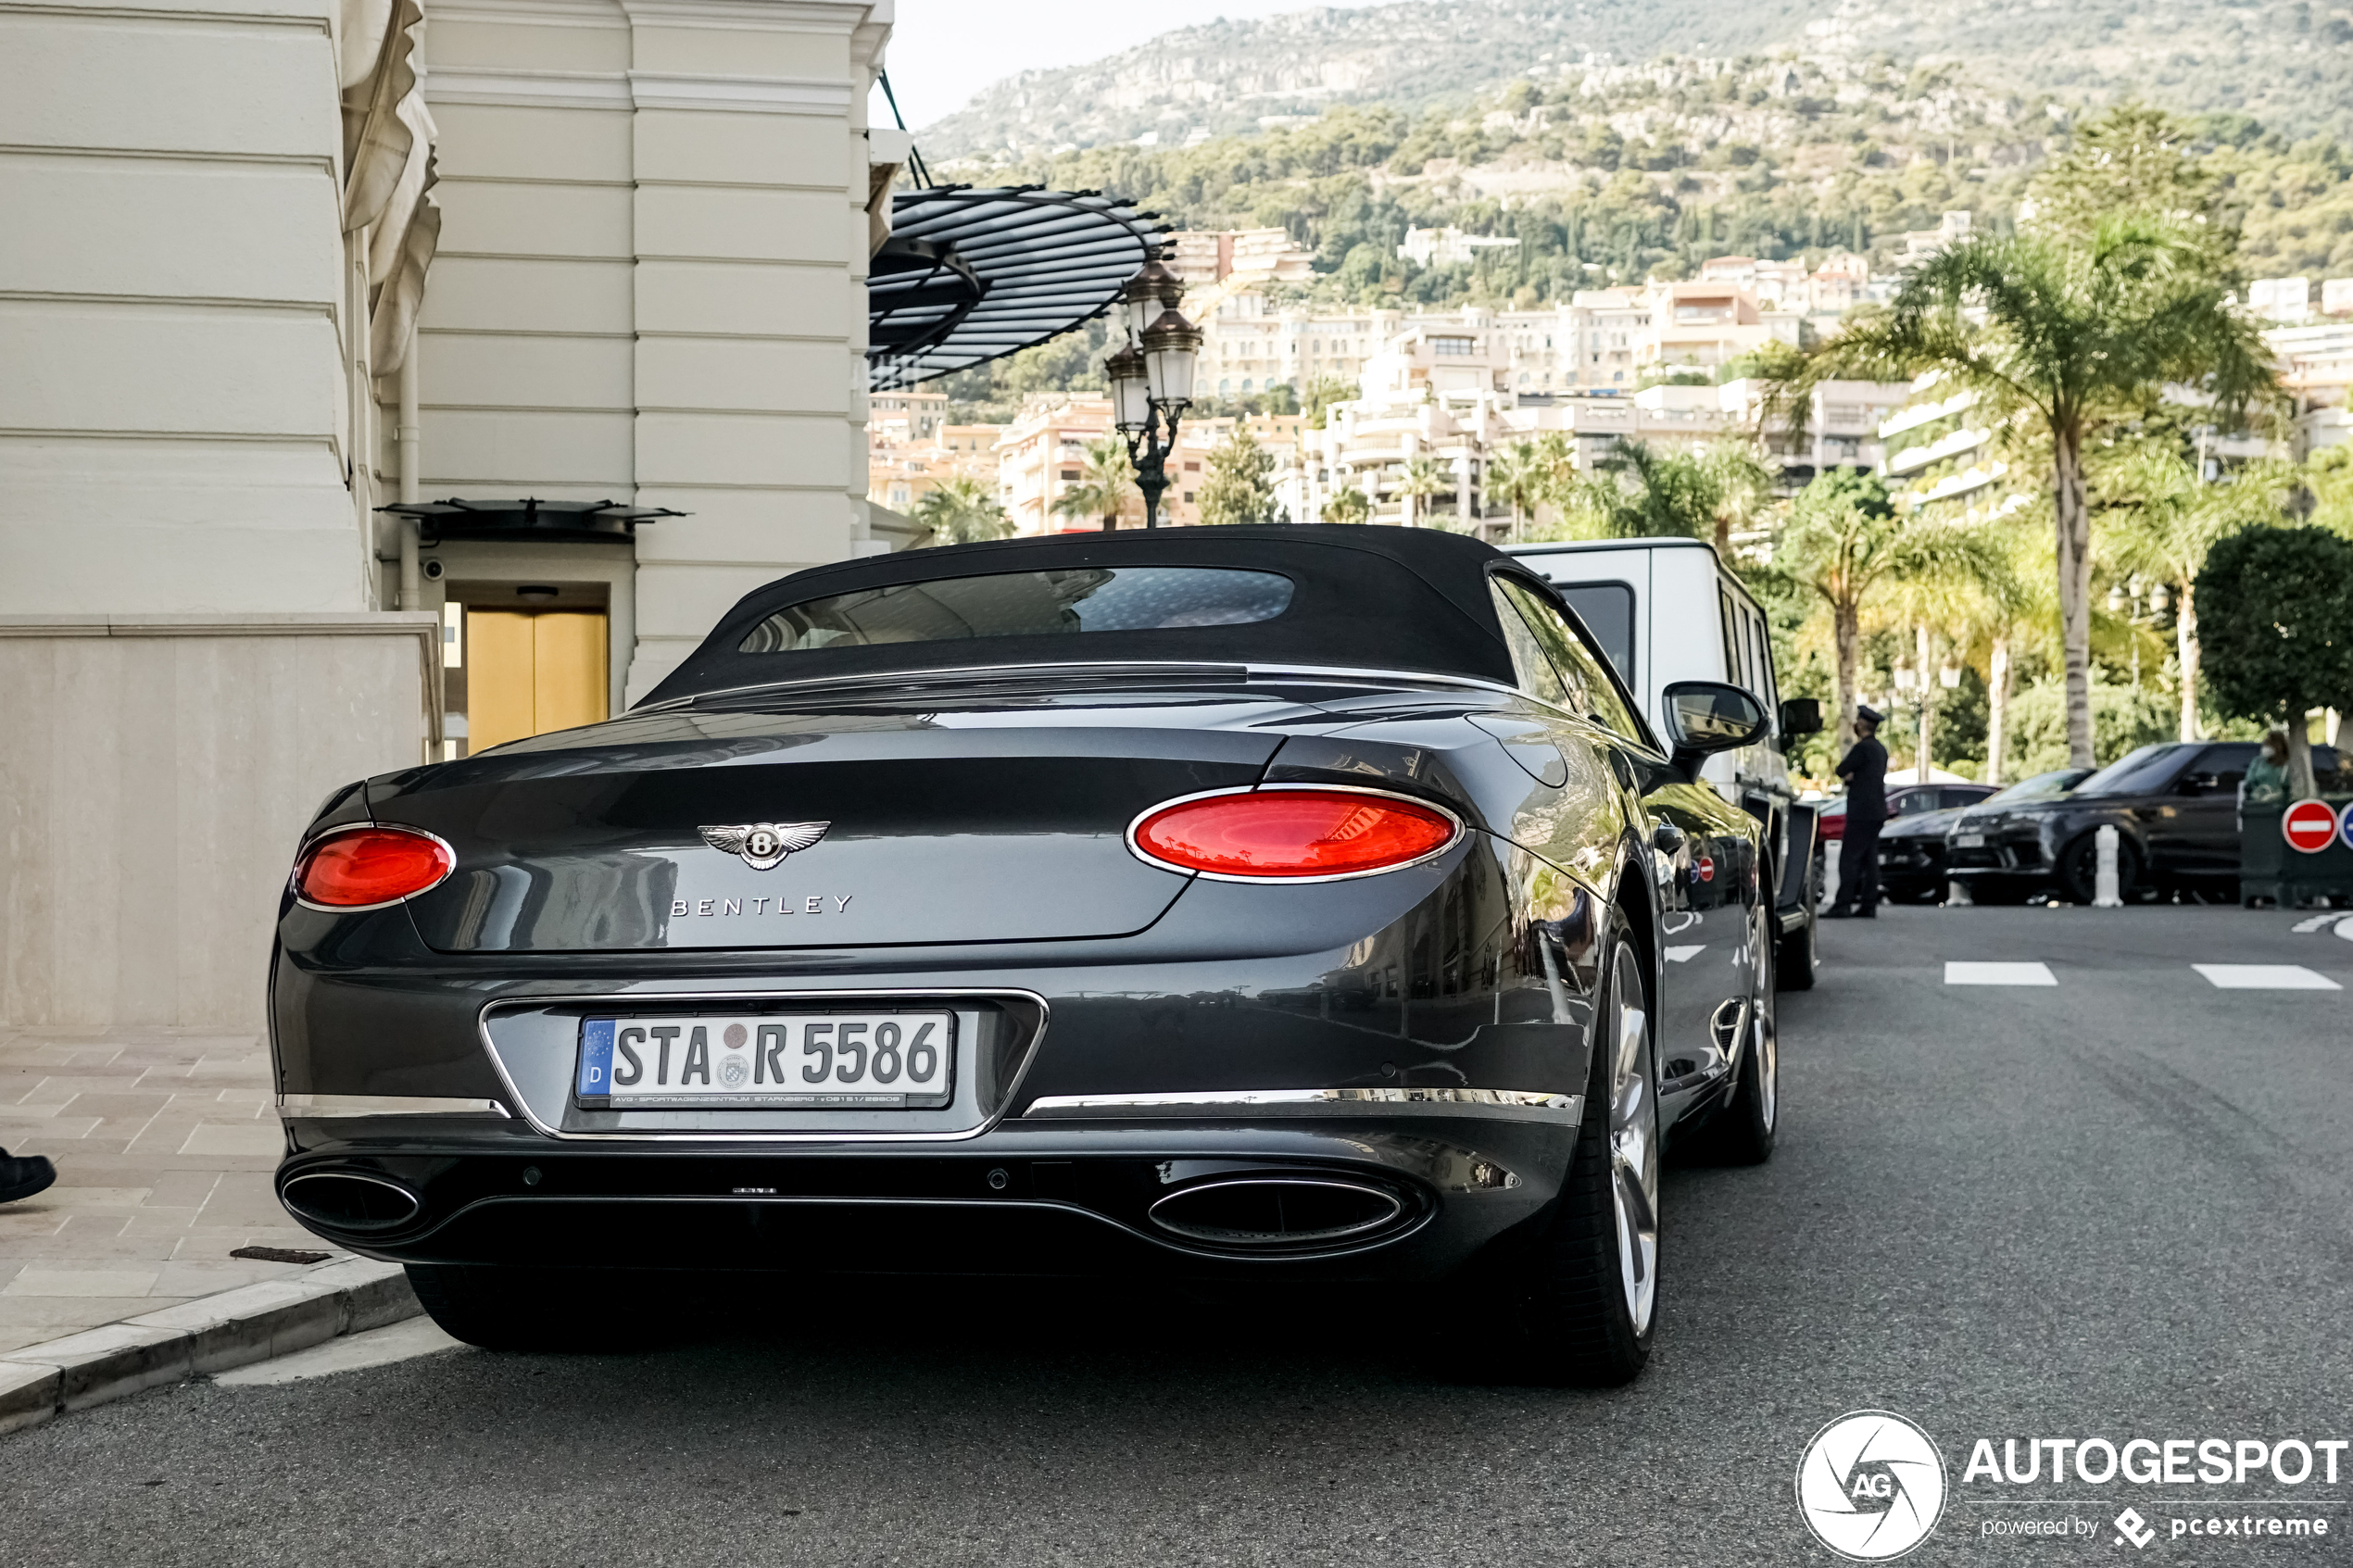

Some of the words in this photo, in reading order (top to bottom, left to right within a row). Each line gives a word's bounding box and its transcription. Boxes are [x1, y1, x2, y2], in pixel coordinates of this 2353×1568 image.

[672, 895, 852, 917] BENTLEY
[614, 1025, 711, 1085] STA
[754, 1024, 786, 1085] R
[802, 1022, 937, 1084] 5586
[590, 1066, 602, 1084] D
